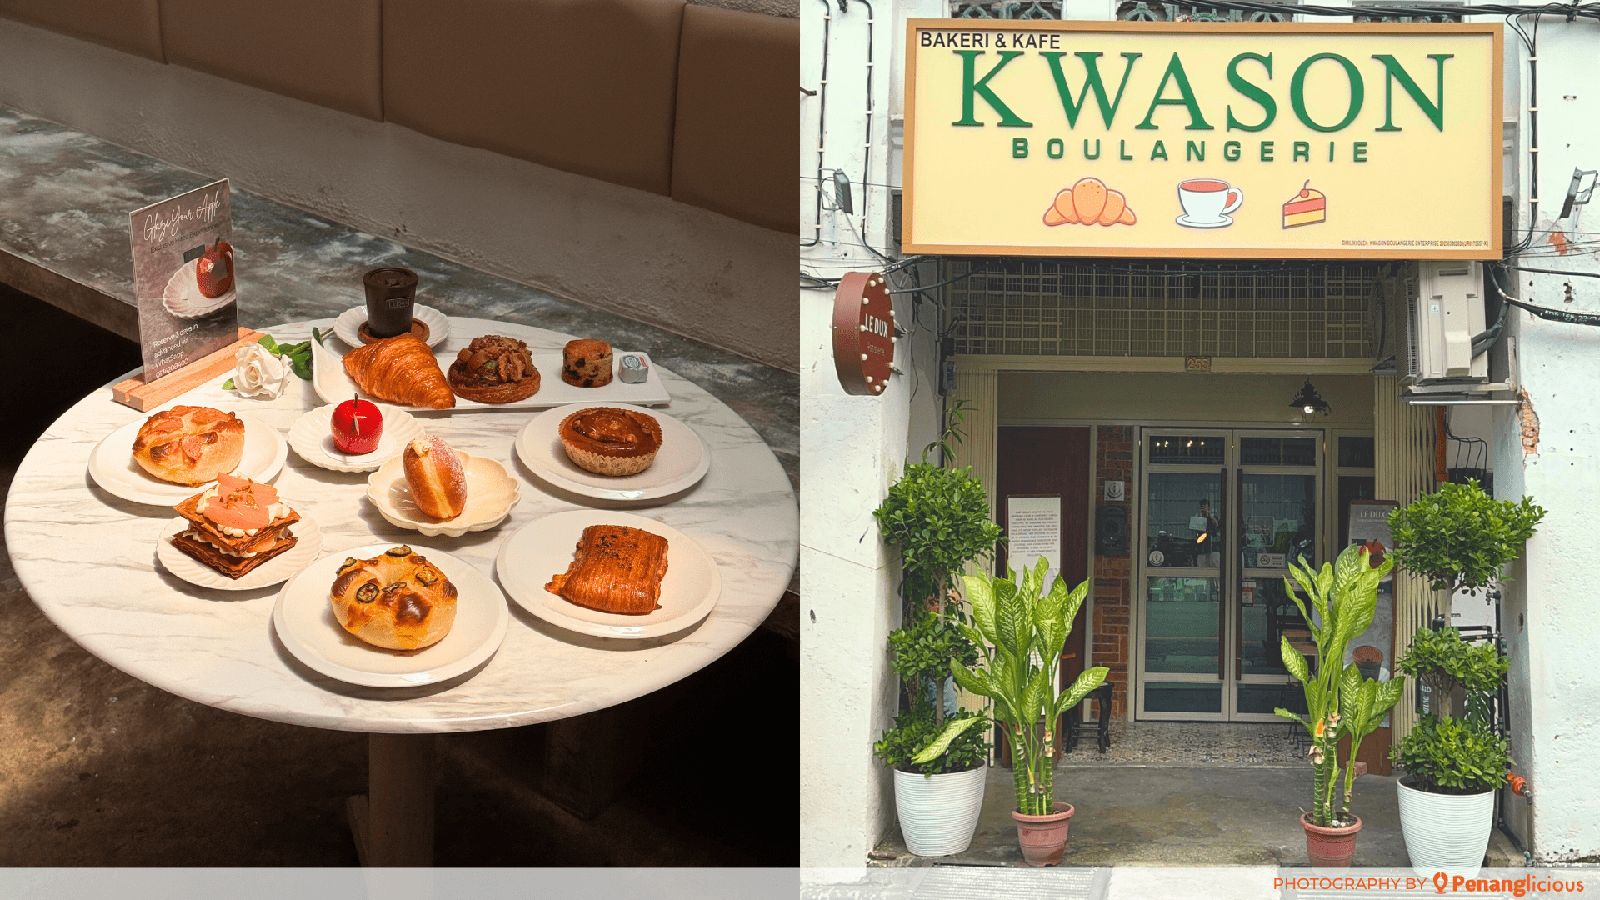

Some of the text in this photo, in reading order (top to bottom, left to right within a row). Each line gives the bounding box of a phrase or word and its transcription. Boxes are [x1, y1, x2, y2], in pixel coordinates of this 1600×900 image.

[921, 32, 1061, 49] BAKERI & KAFE
[952, 50, 1454, 133] KWASON
[1012, 138, 1368, 162] BOULANGERIE
[865, 313, 888, 338] LE DUX
